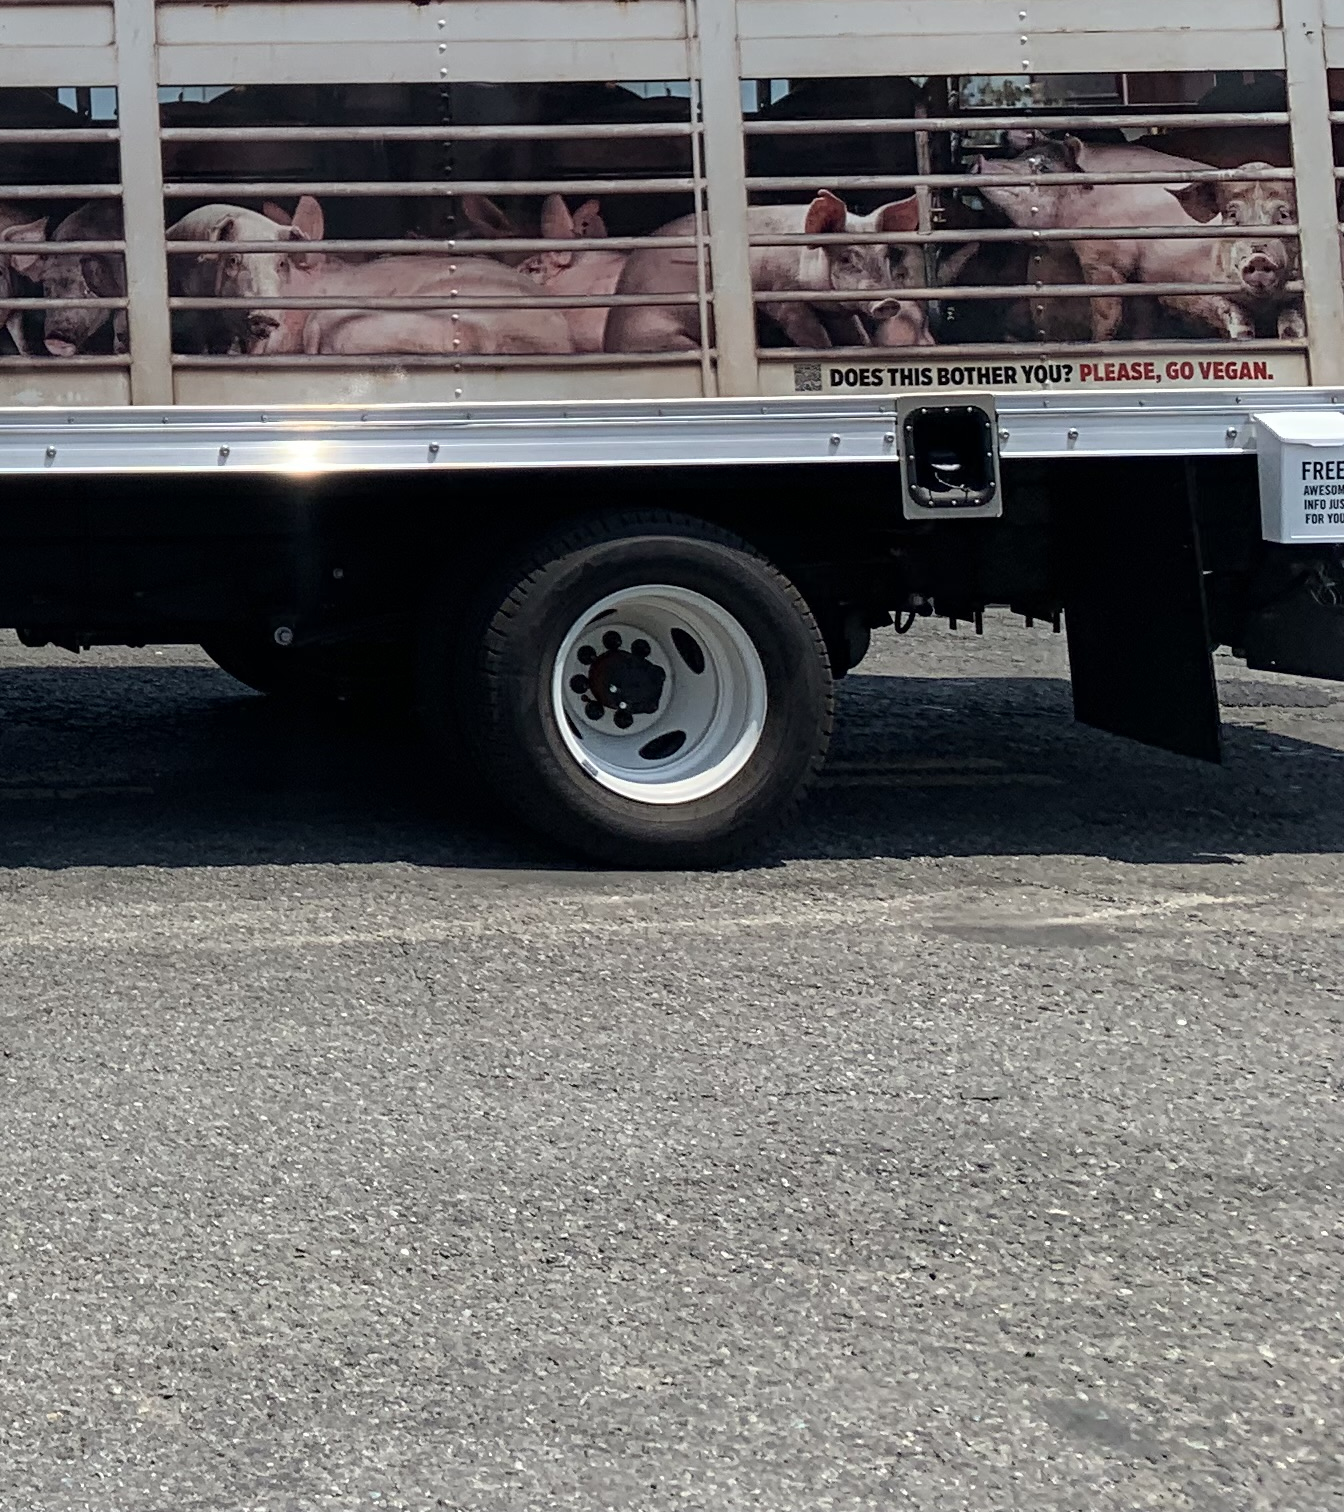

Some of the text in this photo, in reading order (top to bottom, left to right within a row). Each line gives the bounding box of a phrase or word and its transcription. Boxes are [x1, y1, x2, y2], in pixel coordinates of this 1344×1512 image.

[830, 361, 1274, 386] DOES THIS BOTHER YOU? PLEASE, GO VEGAN.
[1302, 461, 1344, 480] FREE
[1304, 499, 1326, 510] INFO
[1305, 513, 1324, 524] FOR
